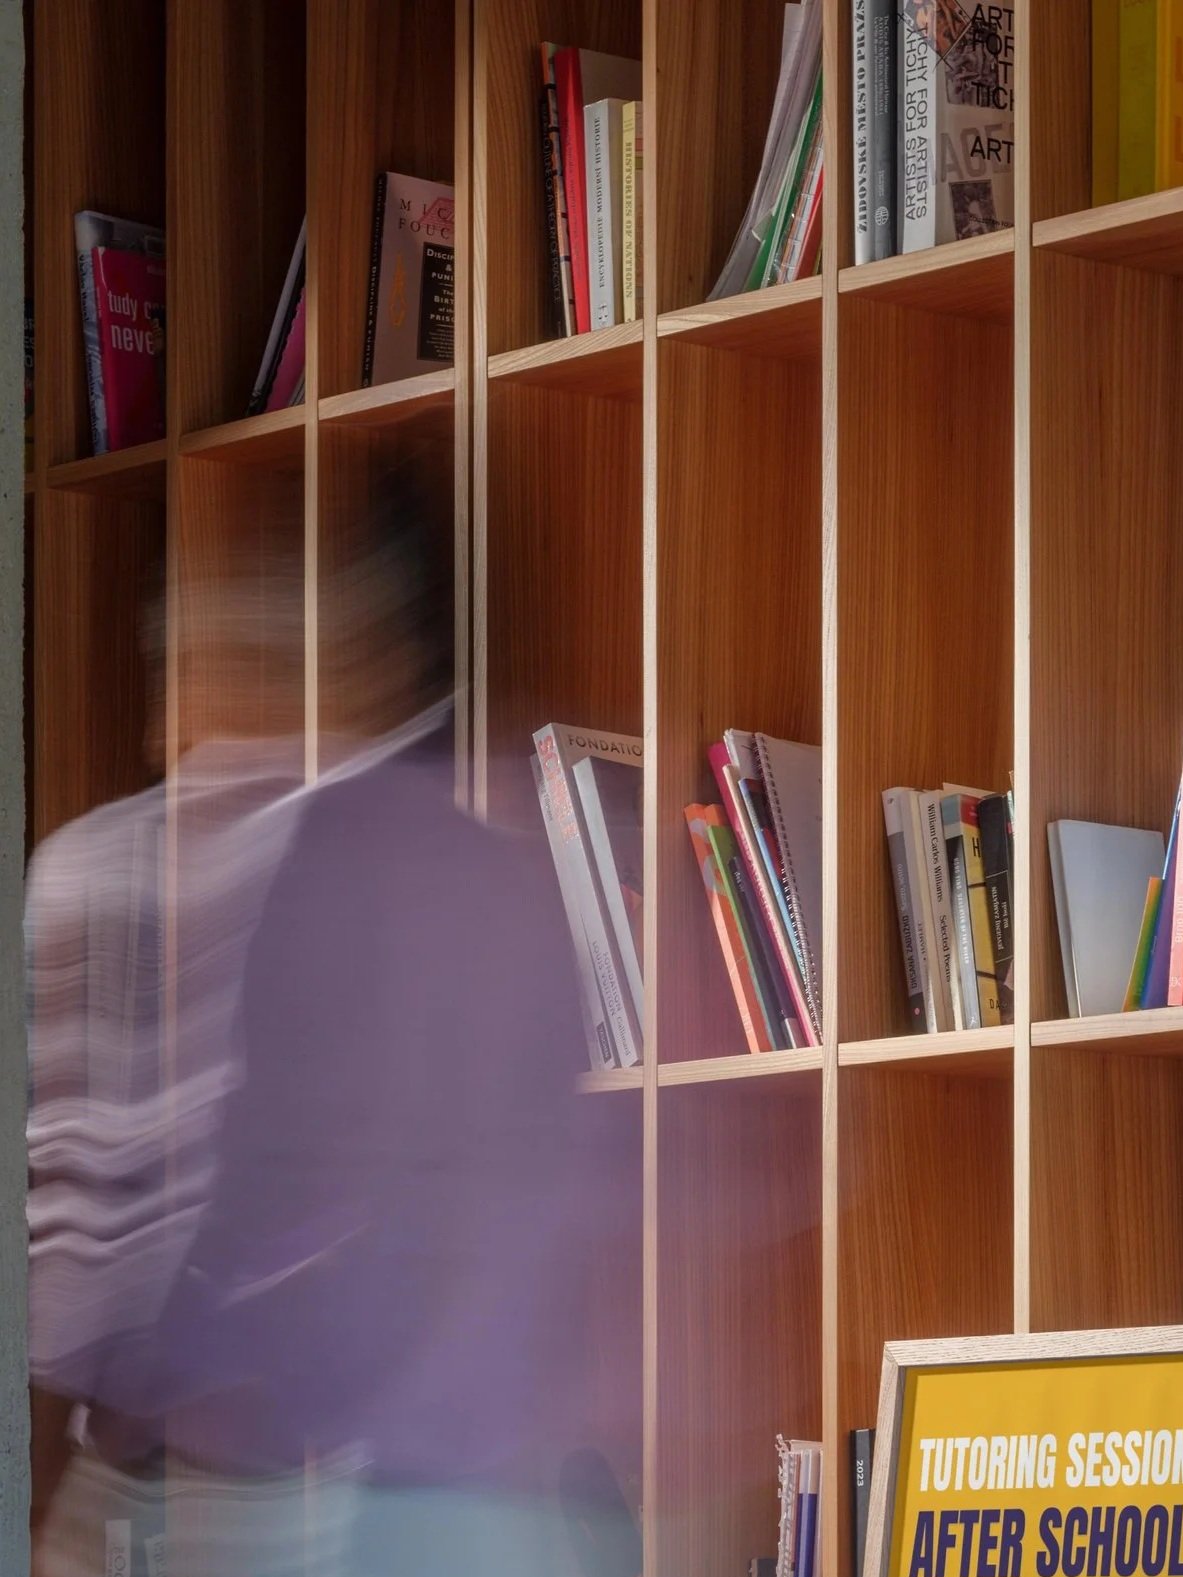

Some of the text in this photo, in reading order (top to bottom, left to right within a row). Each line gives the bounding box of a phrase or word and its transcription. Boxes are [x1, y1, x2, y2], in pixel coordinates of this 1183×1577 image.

[593, 118, 601, 164] HISTORIE
[905, 27, 917, 221] ARTISTS FOR TICHY
[916, 24, 928, 219] TICHY FOR ARTISTS
[597, 217, 605, 288] ENCYKLOPEDIE
[625, 219, 632, 235] OF
[927, 803, 953, 983] William Carlos Williams Selected Poems
[906, 955, 918, 989] OKSANA
[856, 1459, 864, 1487] 2023
[920, 1436, 1057, 1492] TUTORING
